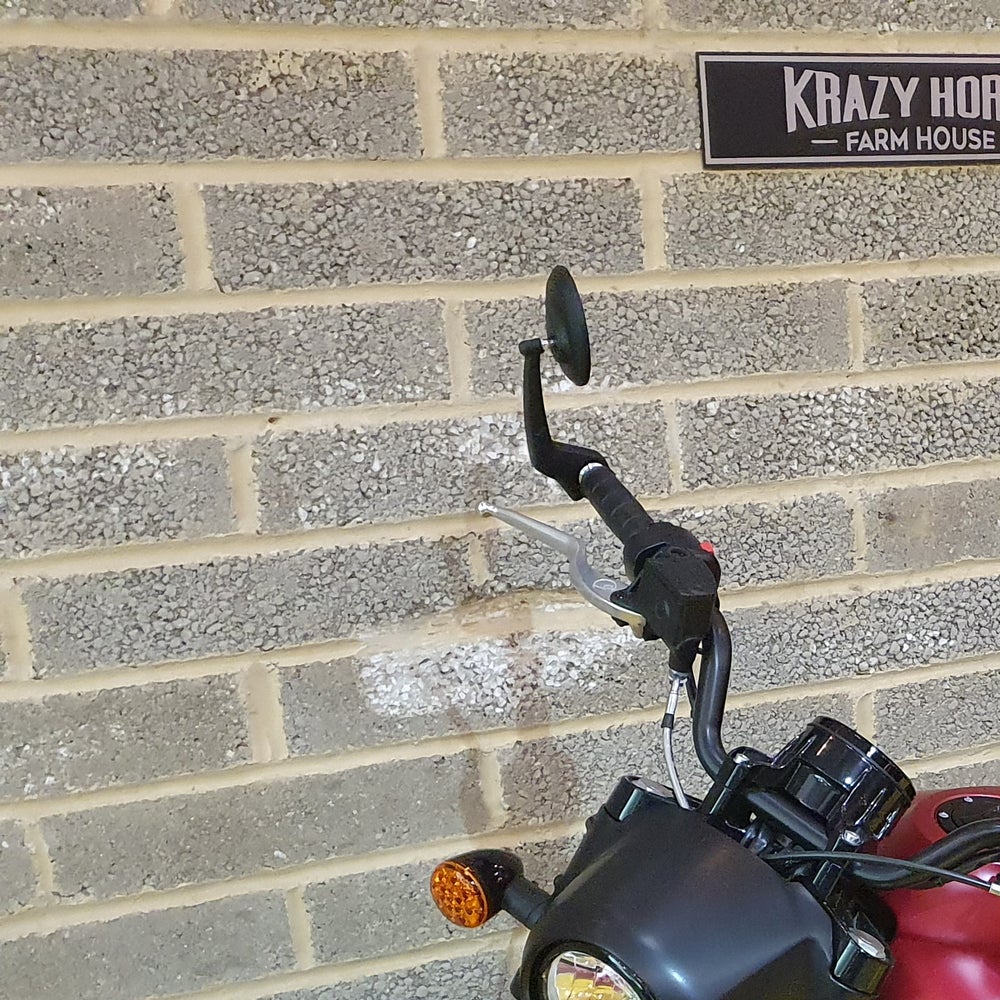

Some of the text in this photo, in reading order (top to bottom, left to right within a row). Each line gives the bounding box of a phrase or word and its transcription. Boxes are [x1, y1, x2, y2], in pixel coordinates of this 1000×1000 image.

[783, 65, 920, 133] KRAZY
[845, 125, 996, 152] FARM HOUSE
